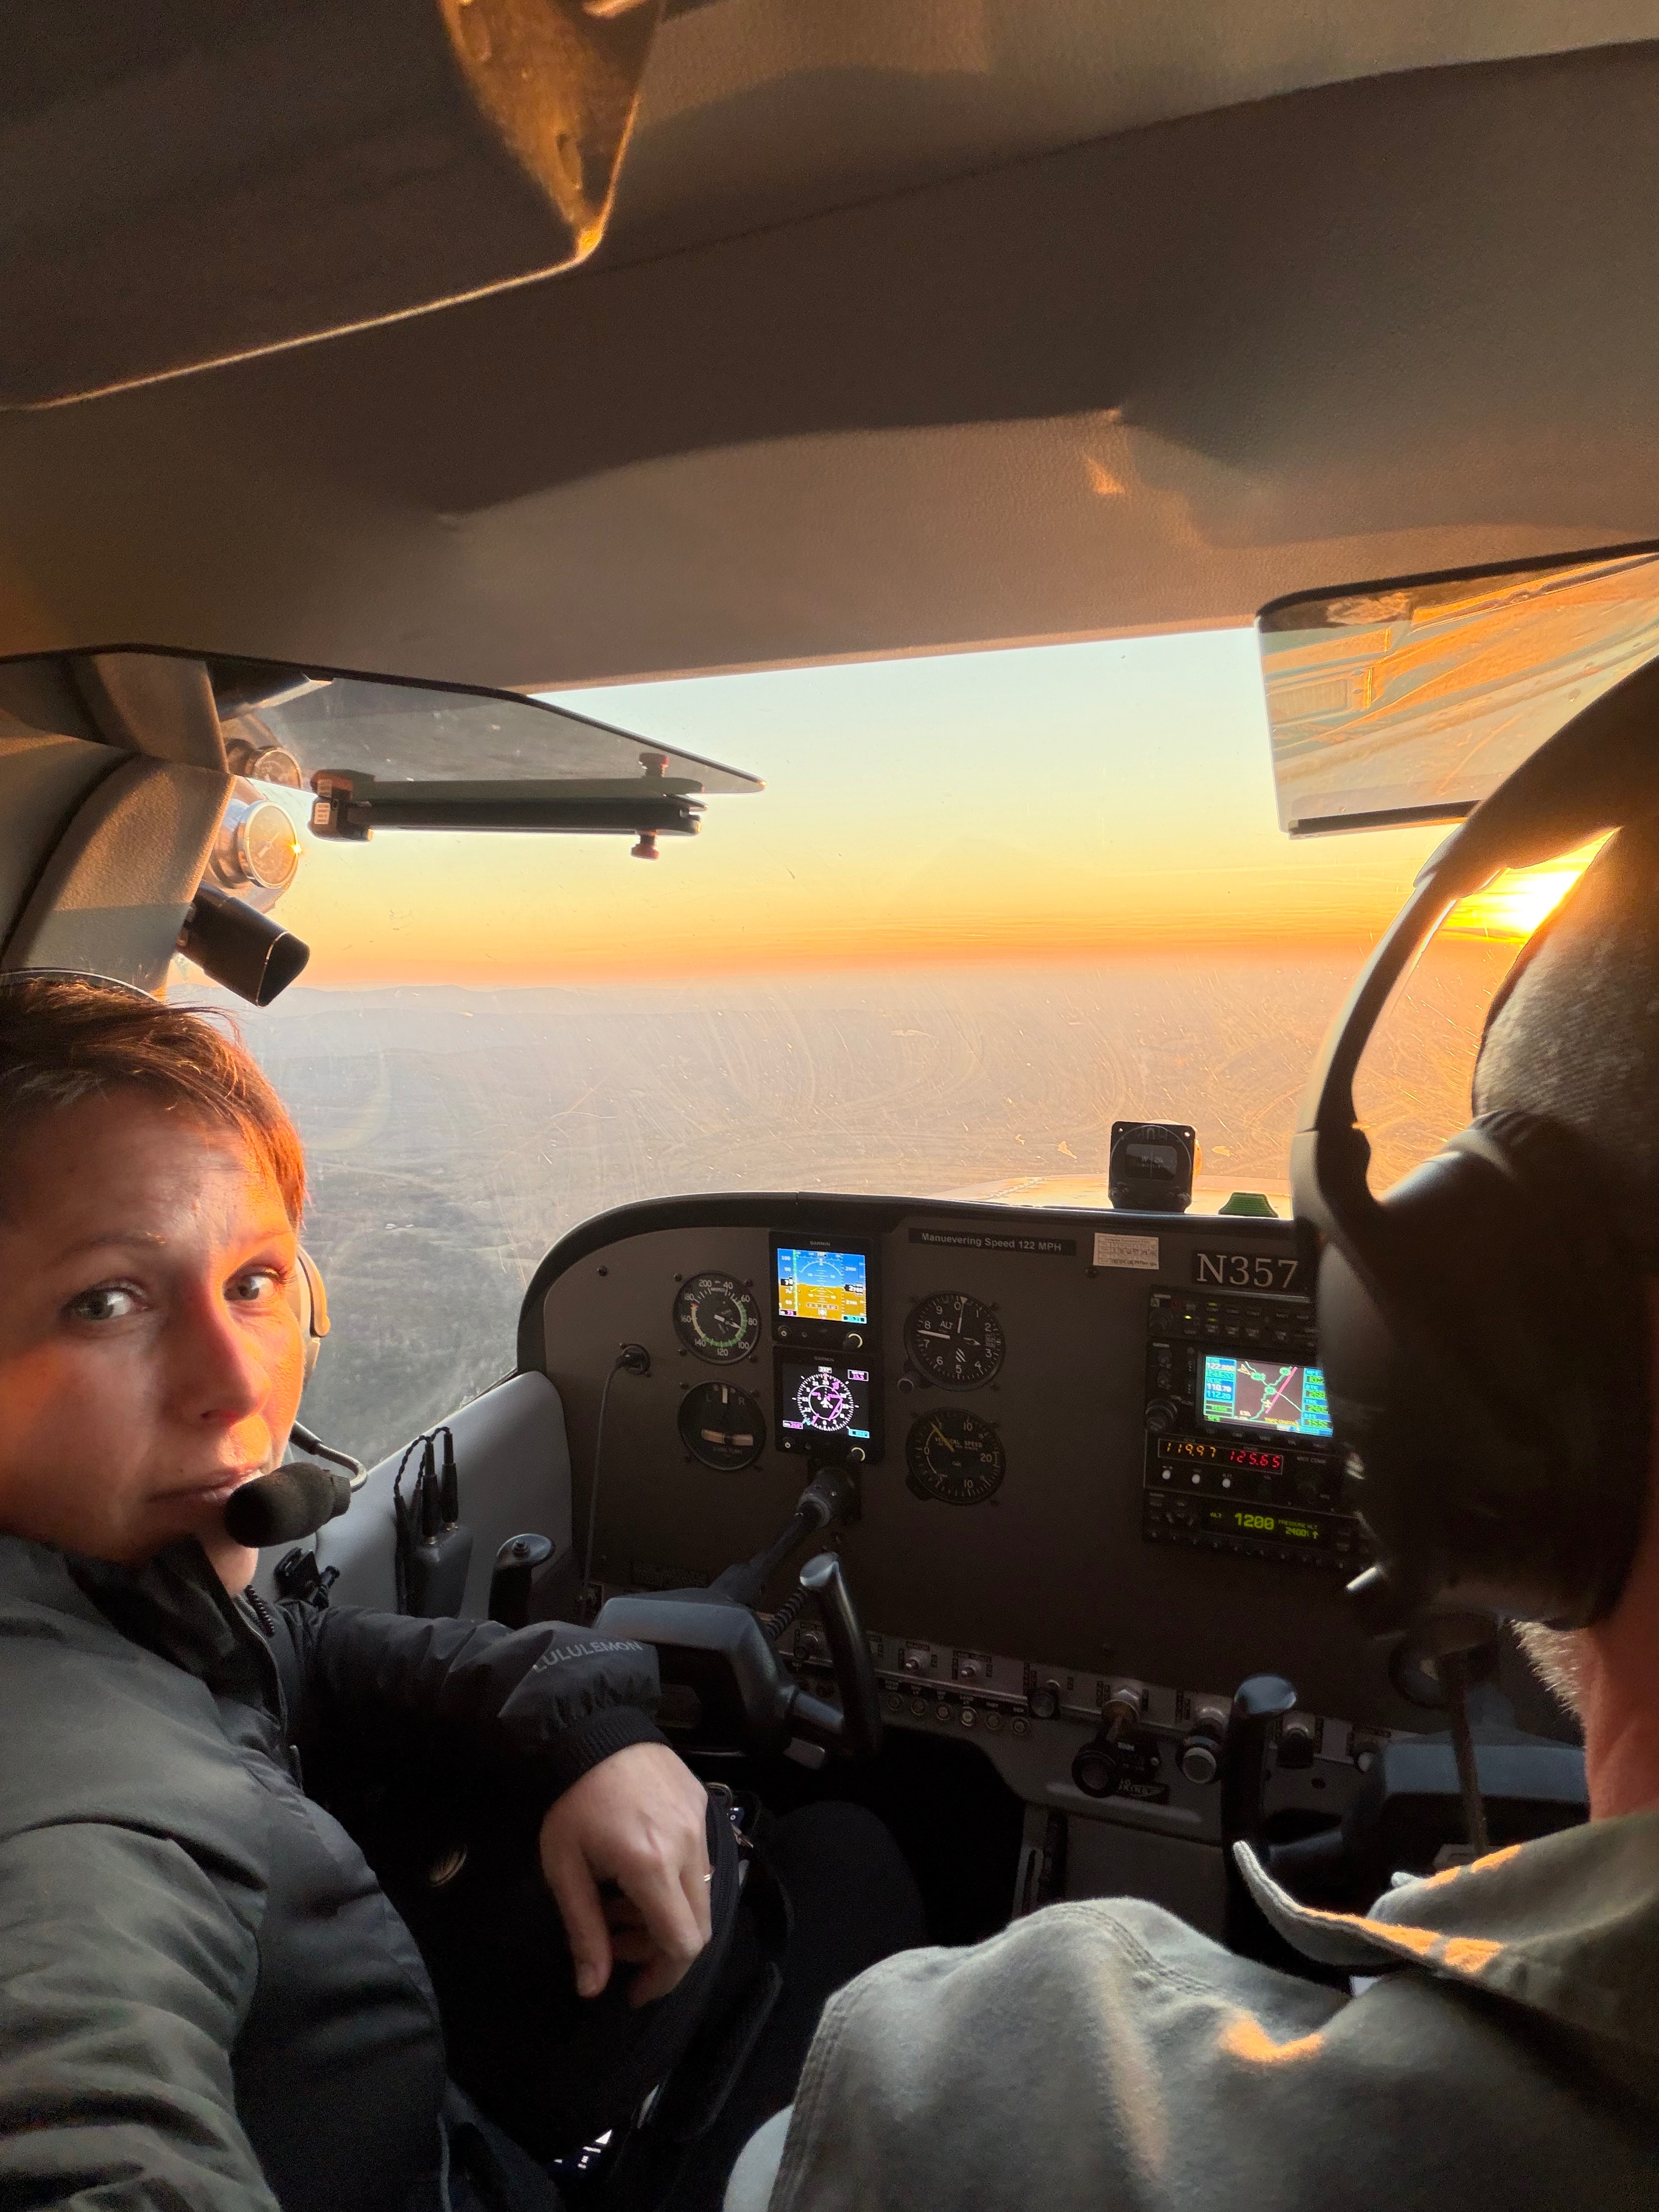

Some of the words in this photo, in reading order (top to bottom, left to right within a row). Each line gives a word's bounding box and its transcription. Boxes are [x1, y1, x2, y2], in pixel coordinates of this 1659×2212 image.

[922, 1233, 982, 1247] Manuevering
[984, 1237, 1015, 1249] Speed
[1018, 1241, 1035, 1250] 122
[1038, 1242, 1061, 1251] MPH
[1196, 1253, 1298, 1288] N357
[936, 1306, 943, 1315] 9
[954, 1302, 961, 1311] 0
[924, 1320, 931, 1330] 8
[939, 1320, 954, 1330] ALT
[985, 1322, 992, 1332] 2
[695, 1339, 706, 1347] 140
[924, 1339, 931, 1349] 7
[985, 1348, 992, 1358] 3
[936, 1356, 943, 1365] 6
[974, 1360, 982, 1369] 4
[955, 1364, 962, 1374] 5
[739, 1397, 745, 1406] R
[963, 1422, 973, 1431] 10
[924, 1446, 929, 1455] 0
[980, 1453, 992, 1462] 20
[1229, 1450, 1280, 1468] 125.65
[964, 1480, 973, 1489] 10
[1234, 1512, 1275, 1530] 1200
[533, 1642, 643, 1672] LULULEMON
